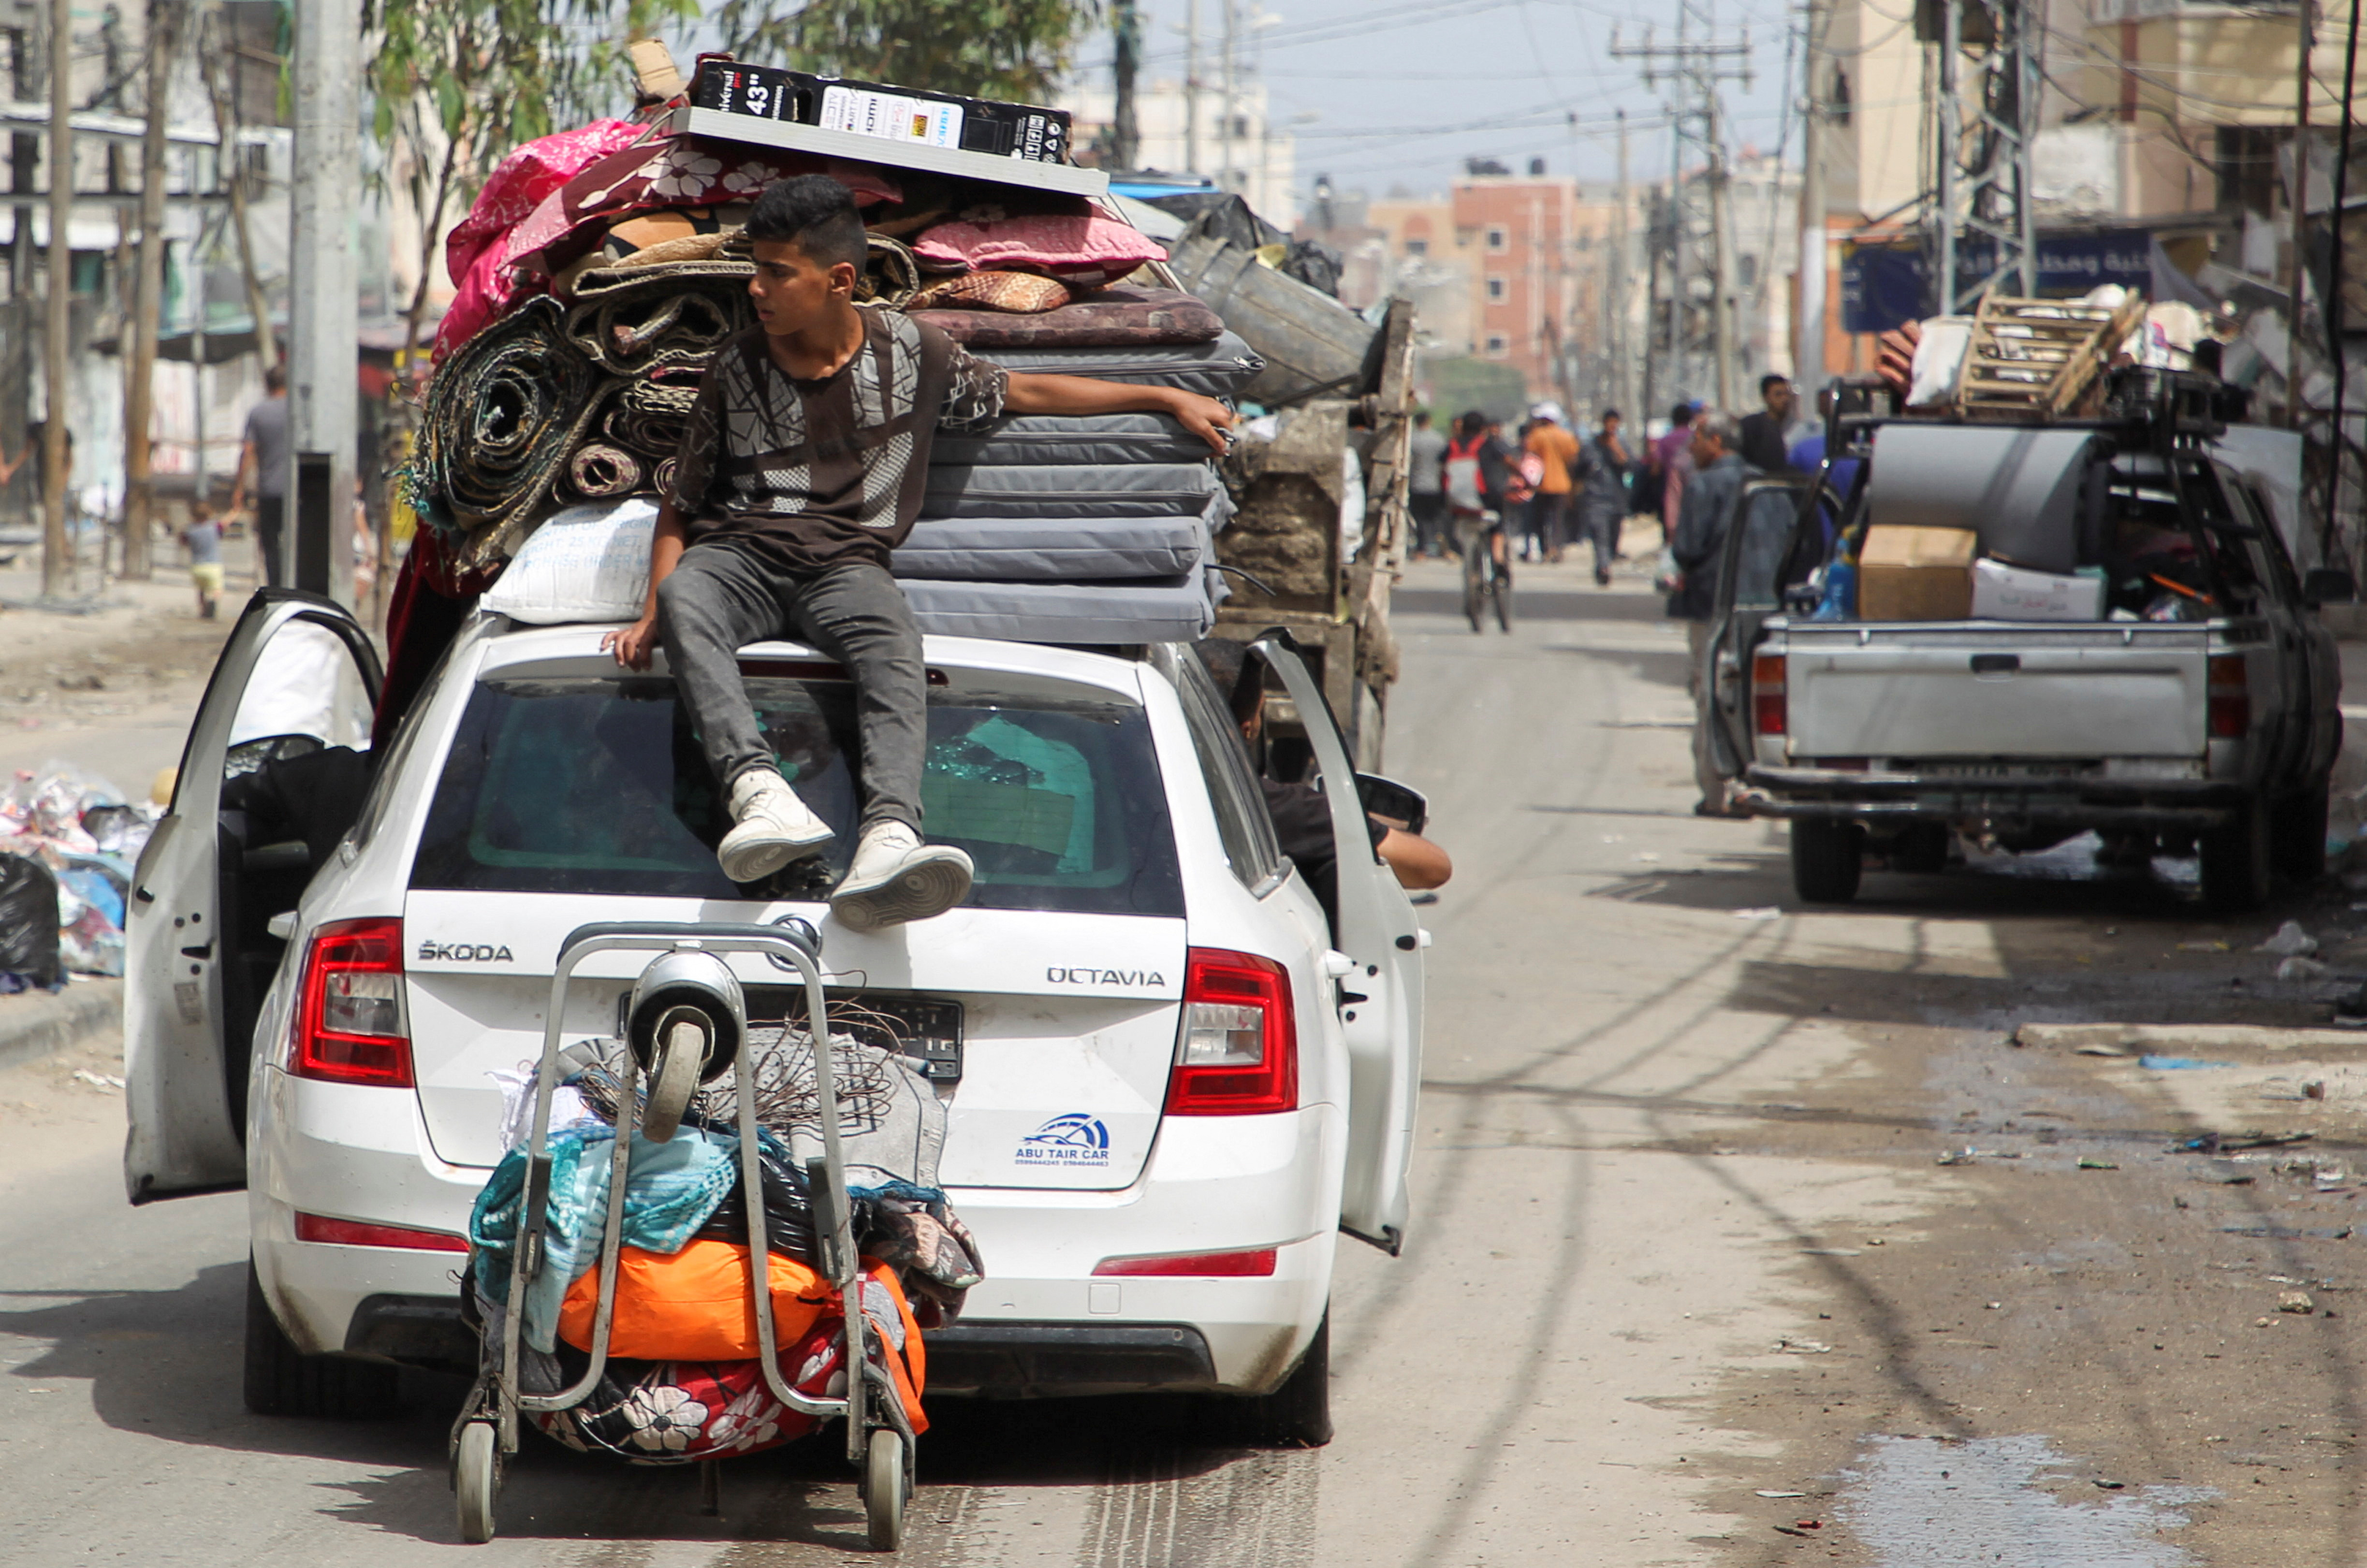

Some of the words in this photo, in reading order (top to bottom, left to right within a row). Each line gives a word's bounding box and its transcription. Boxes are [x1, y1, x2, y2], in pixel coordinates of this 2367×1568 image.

[733, 72, 742, 88] pro
[746, 73, 769, 115] 43"
[419, 939, 514, 962] ŠKODA
[1047, 967, 1166, 987] OCTAVIA
[1016, 1148, 1043, 1158] ABU
[1048, 1149, 1077, 1159] TAIR
[1082, 1150, 1109, 1159] CAR
